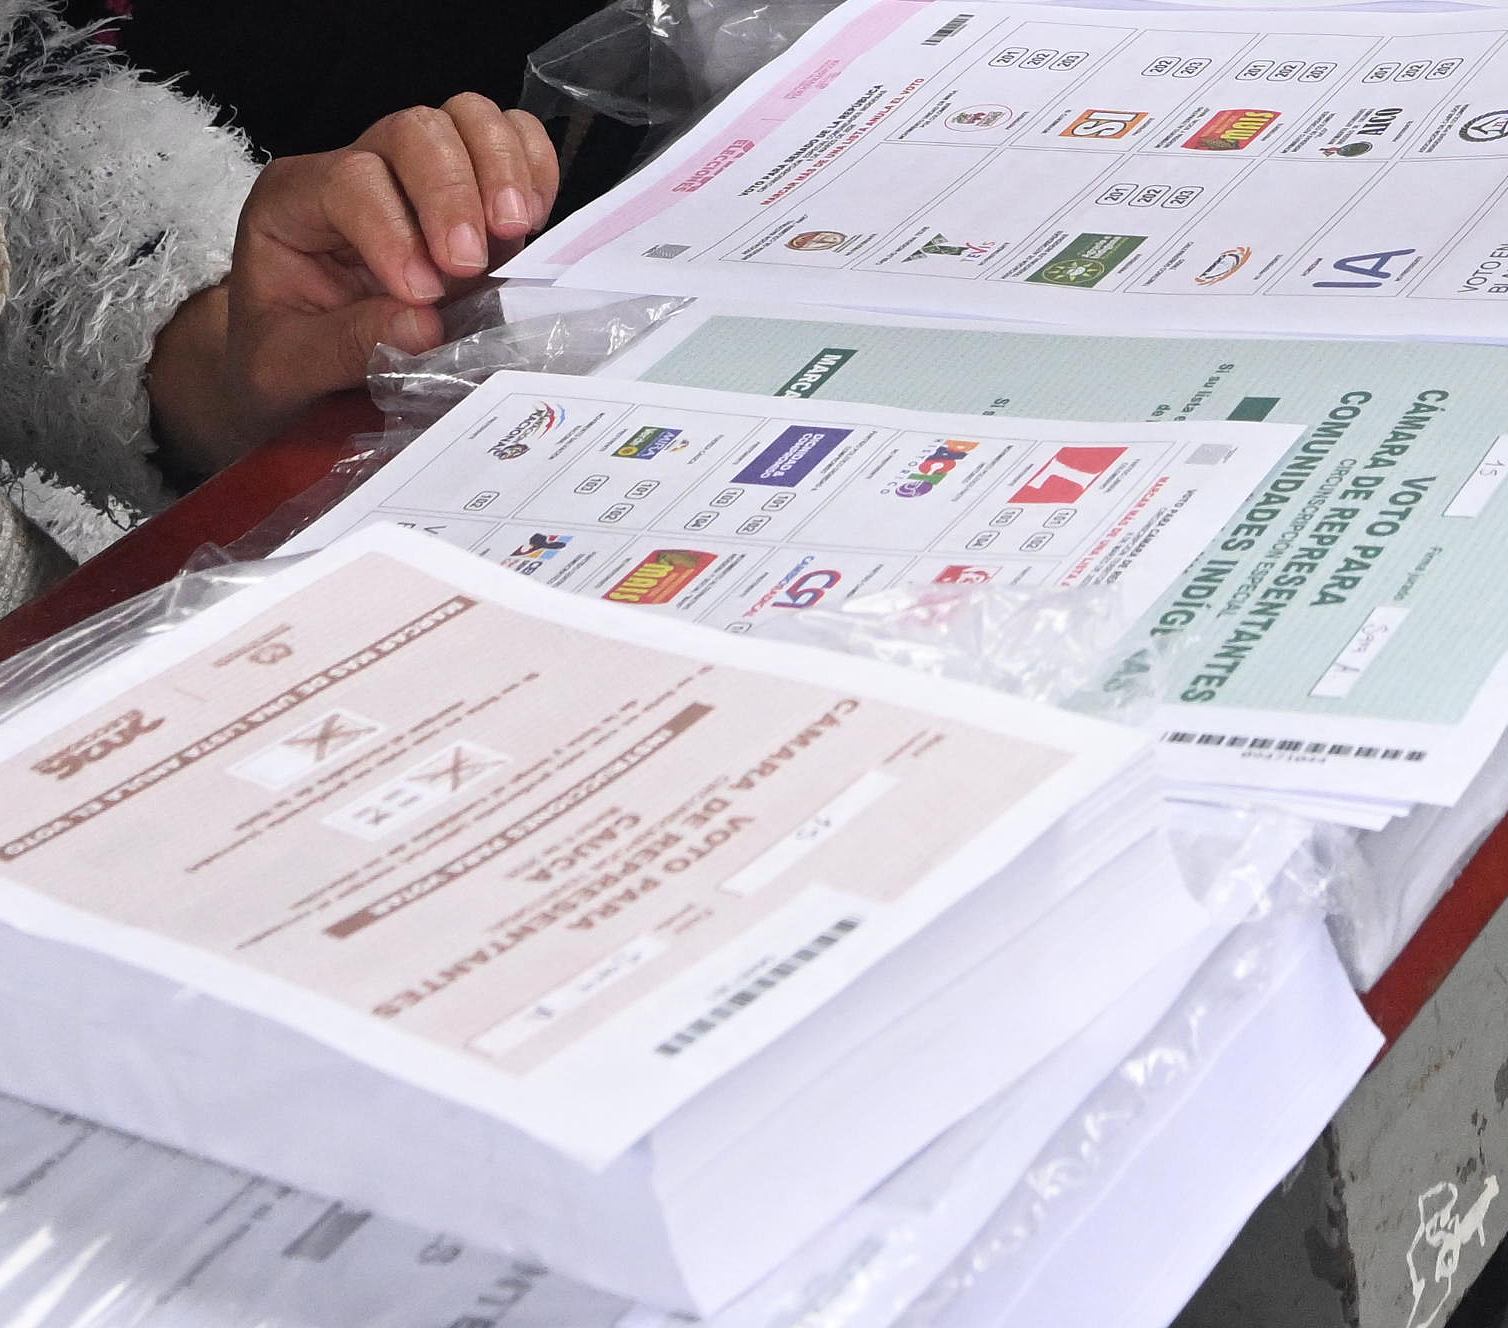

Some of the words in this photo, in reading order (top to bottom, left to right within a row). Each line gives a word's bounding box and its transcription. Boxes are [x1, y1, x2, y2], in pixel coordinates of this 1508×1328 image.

[996, 50, 1016, 64] 201
[1026, 52, 1050, 67] 202
[1056, 54, 1081, 69] 203
[1149, 59, 1174, 74] 202
[1180, 61, 1204, 75] 203
[1243, 64, 1266, 78] 201
[1274, 63, 1298, 79] 202
[1305, 65, 1329, 80] 203
[1370, 66, 1393, 81] 201
[1401, 64, 1424, 79] 202
[1432, 62, 1456, 77] 203
[900, 77, 926, 97] VOTO
[1356, 107, 1404, 136] AICO
[1103, 187, 1124, 203] 201
[1137, 187, 1162, 203] 202
[1169, 189, 1196, 206] 203
[1457, 259, 1502, 294] VOTO
[1181, 390, 1214, 413] lista
[1363, 388, 1450, 471] CÁMARA
[759, 432, 814, 479] COMPROMISO
[780, 433, 826, 471] DIGNIDAD
[1219, 390, 1373, 553] COMUNIDADES
[580, 476, 602, 492] 103
[630, 482, 654, 497] 101
[1337, 475, 1386, 502] DE
[469, 493, 493, 509] 102
[716, 489, 738, 505] 103
[768, 493, 789, 510] 101
[604, 505, 629, 521] 102
[1260, 457, 1357, 560] CIRCUNSCRIPCIÓN
[1364, 475, 1437, 538] VOTO
[690, 512, 714, 529] 104
[743, 517, 765, 533] 102
[996, 510, 1017, 525] 103
[1050, 511, 1070, 526] 101
[1026, 533, 1048, 549] 102
[1308, 544, 1385, 608] PARA
[1180, 505, 1361, 704] REPRESENTANTES
[728, 695, 862, 793] CÁMARA
[685, 795, 734, 831] DE
[522, 812, 643, 885] CAUCA
[662, 814, 757, 875] VOTO
[565, 876, 661, 931] PARA
[371, 831, 684, 1020] REPRESENTANTES
